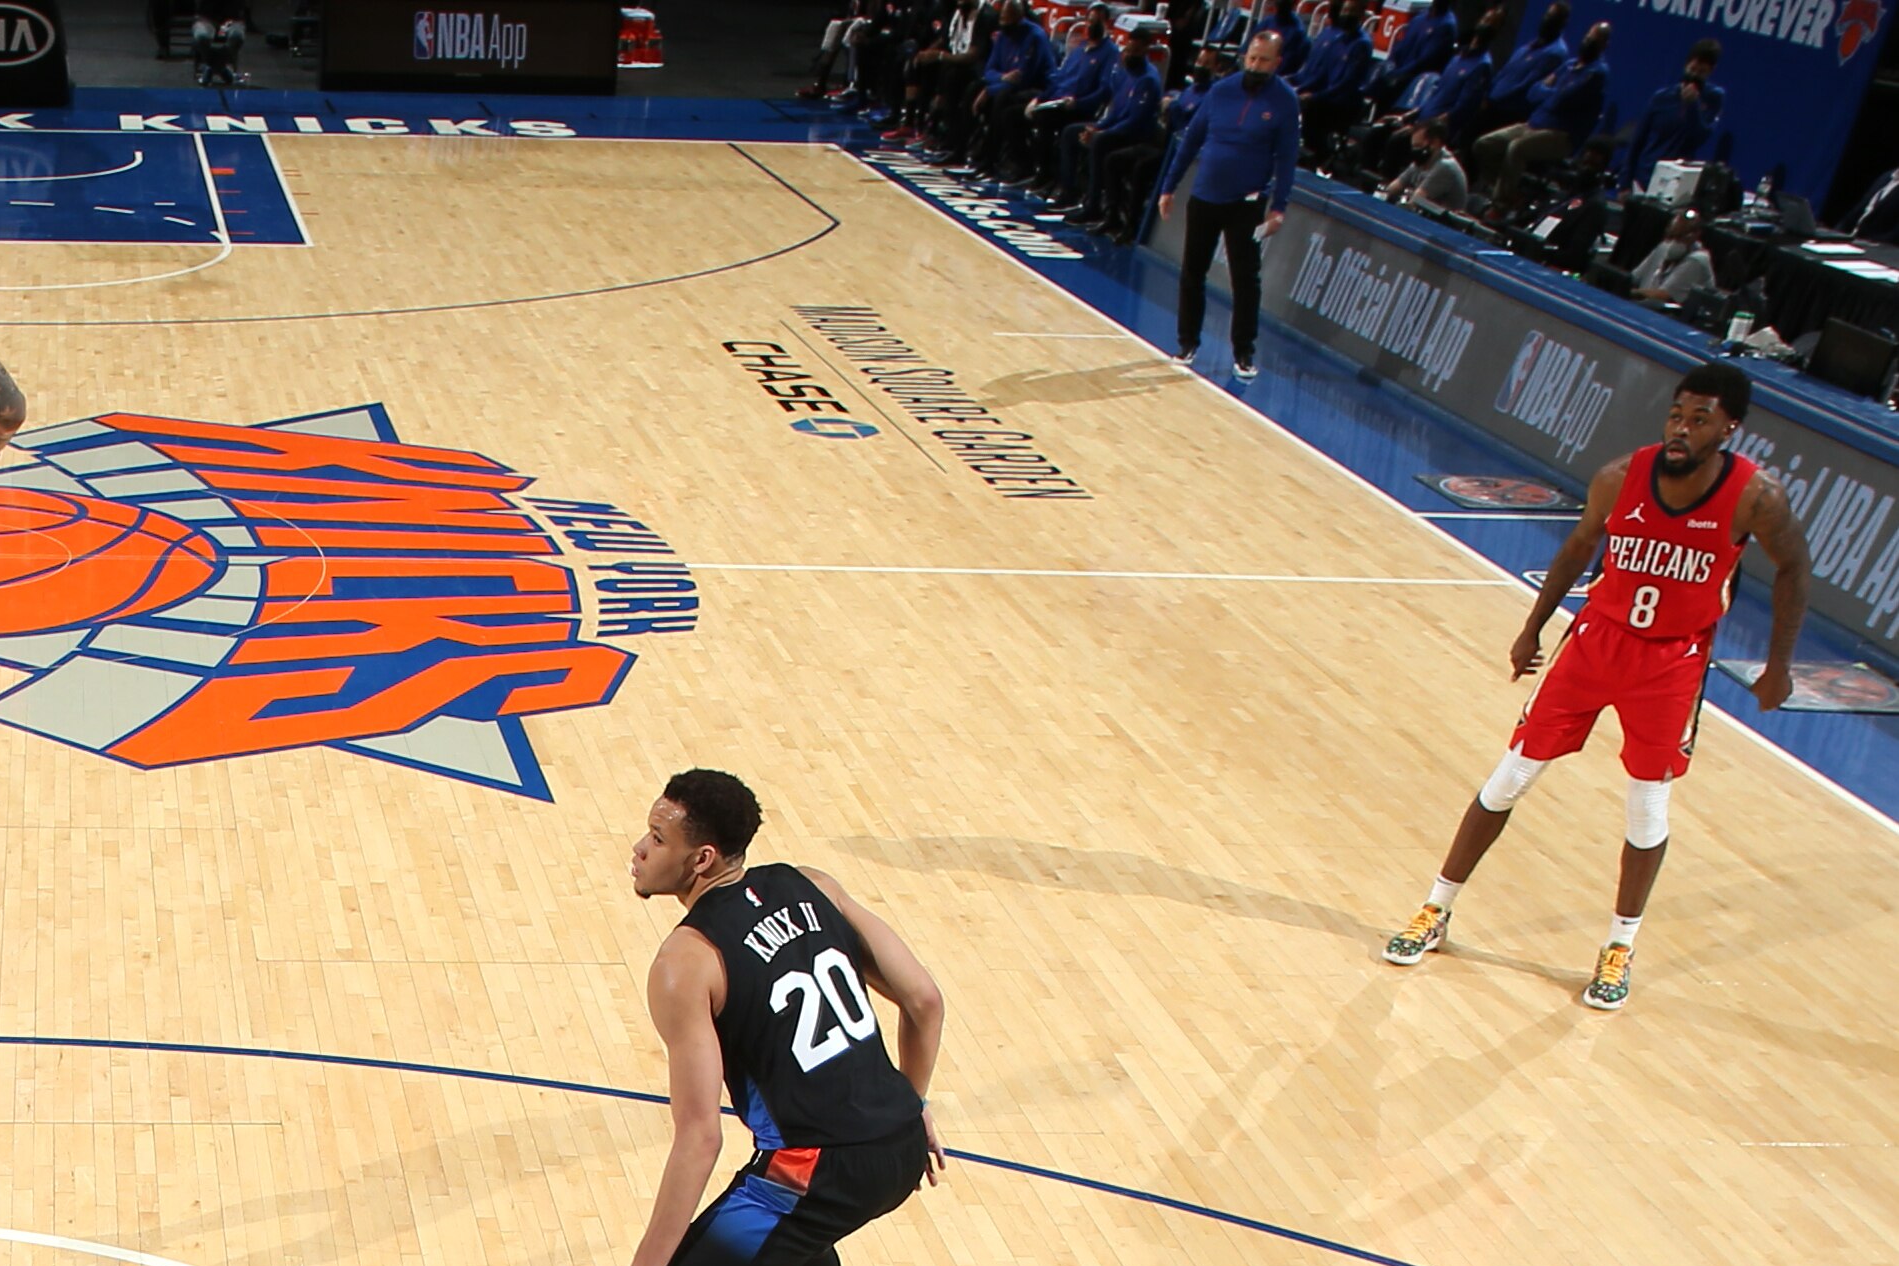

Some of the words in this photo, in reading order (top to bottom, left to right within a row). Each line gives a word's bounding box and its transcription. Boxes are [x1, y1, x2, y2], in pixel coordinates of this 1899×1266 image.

[436, 13, 486, 60] NBA
[488, 14, 527, 69] App
[118, 113, 578, 138] KNICKS
[1289, 232, 1334, 309] The
[1318, 246, 1404, 342] Official
[1378, 275, 1442, 362] NBA
[1416, 295, 1475, 393] App
[721, 341, 850, 414] CHASE
[788, 305, 929, 364] MADISON
[860, 366, 1002, 426] SQUARE
[931, 430, 1096, 500] GARDEN
[1511, 339, 1585, 435] NBA
[1551, 359, 1614, 465] App
[521, 497, 677, 555] NEW
[1687, 518, 1718, 530] ibotta
[91, 408, 639, 772] KNICKS
[1609, 534, 1717, 584] PELICANS
[587, 561, 701, 638] YORK
[1629, 585, 1661, 630] 8
[743, 906, 805, 964] KNOX
[798, 901, 822, 933] II
[768, 947, 877, 1074] 20
